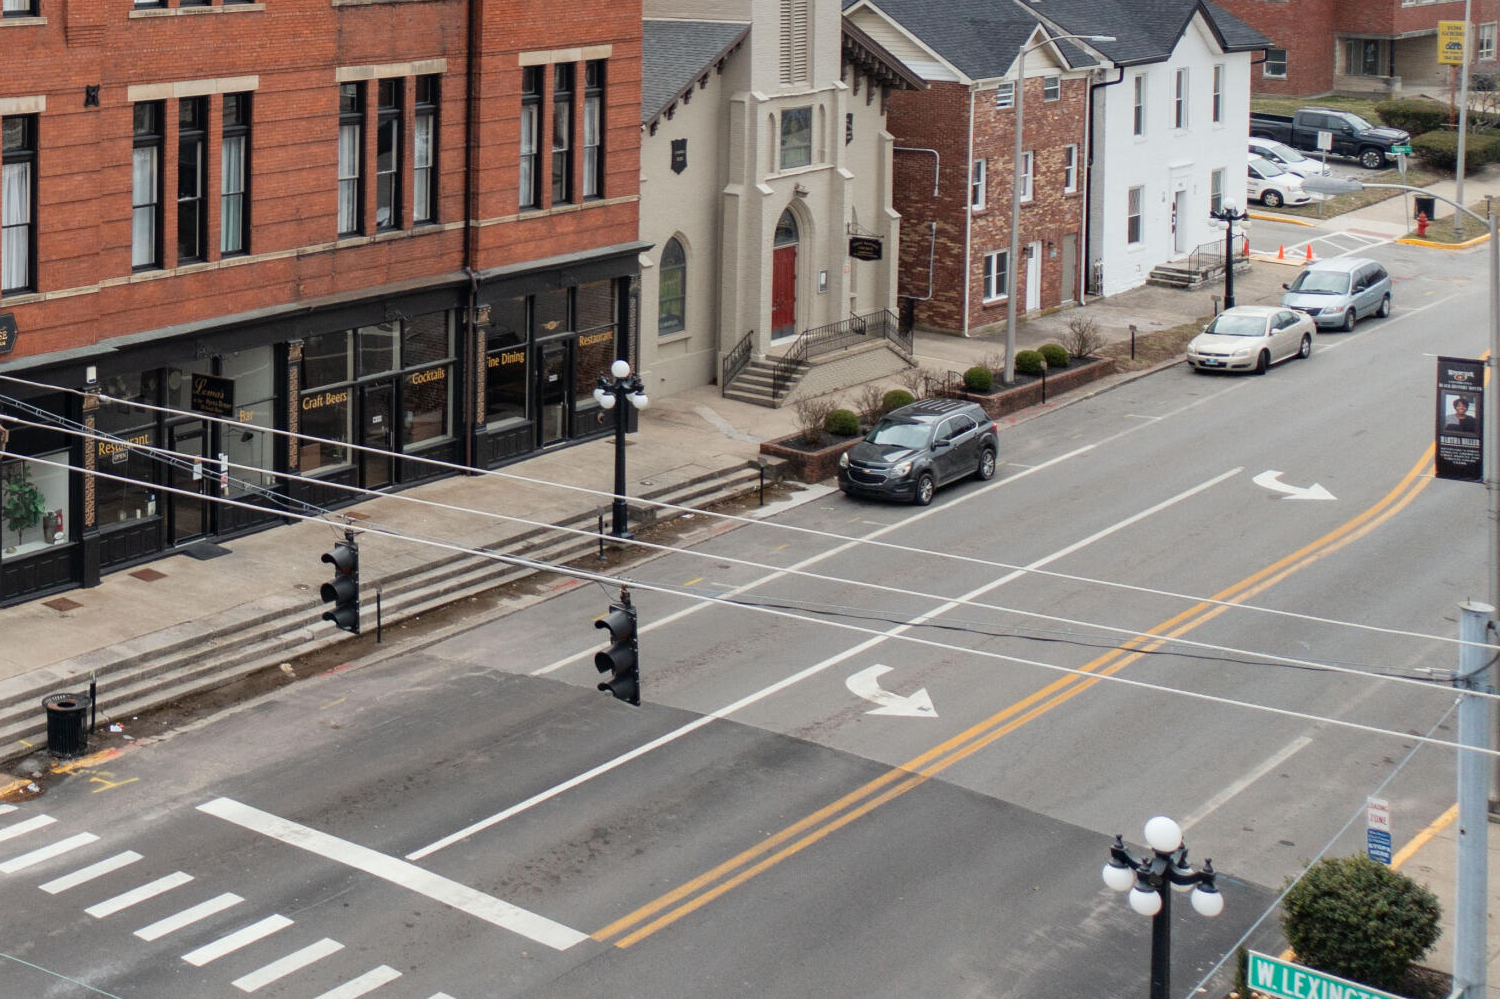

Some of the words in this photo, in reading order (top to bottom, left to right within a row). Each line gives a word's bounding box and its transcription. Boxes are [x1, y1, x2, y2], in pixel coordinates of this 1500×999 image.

[579, 331, 613, 346] Restaurant
[501, 352, 525, 365] Dining
[411, 367, 446, 385] Cocktails
[302, 394, 323, 410] Craft
[325, 392, 347, 406] Beers
[240, 409, 254, 422] Bar
[1257, 959, 1277, 990] W.
